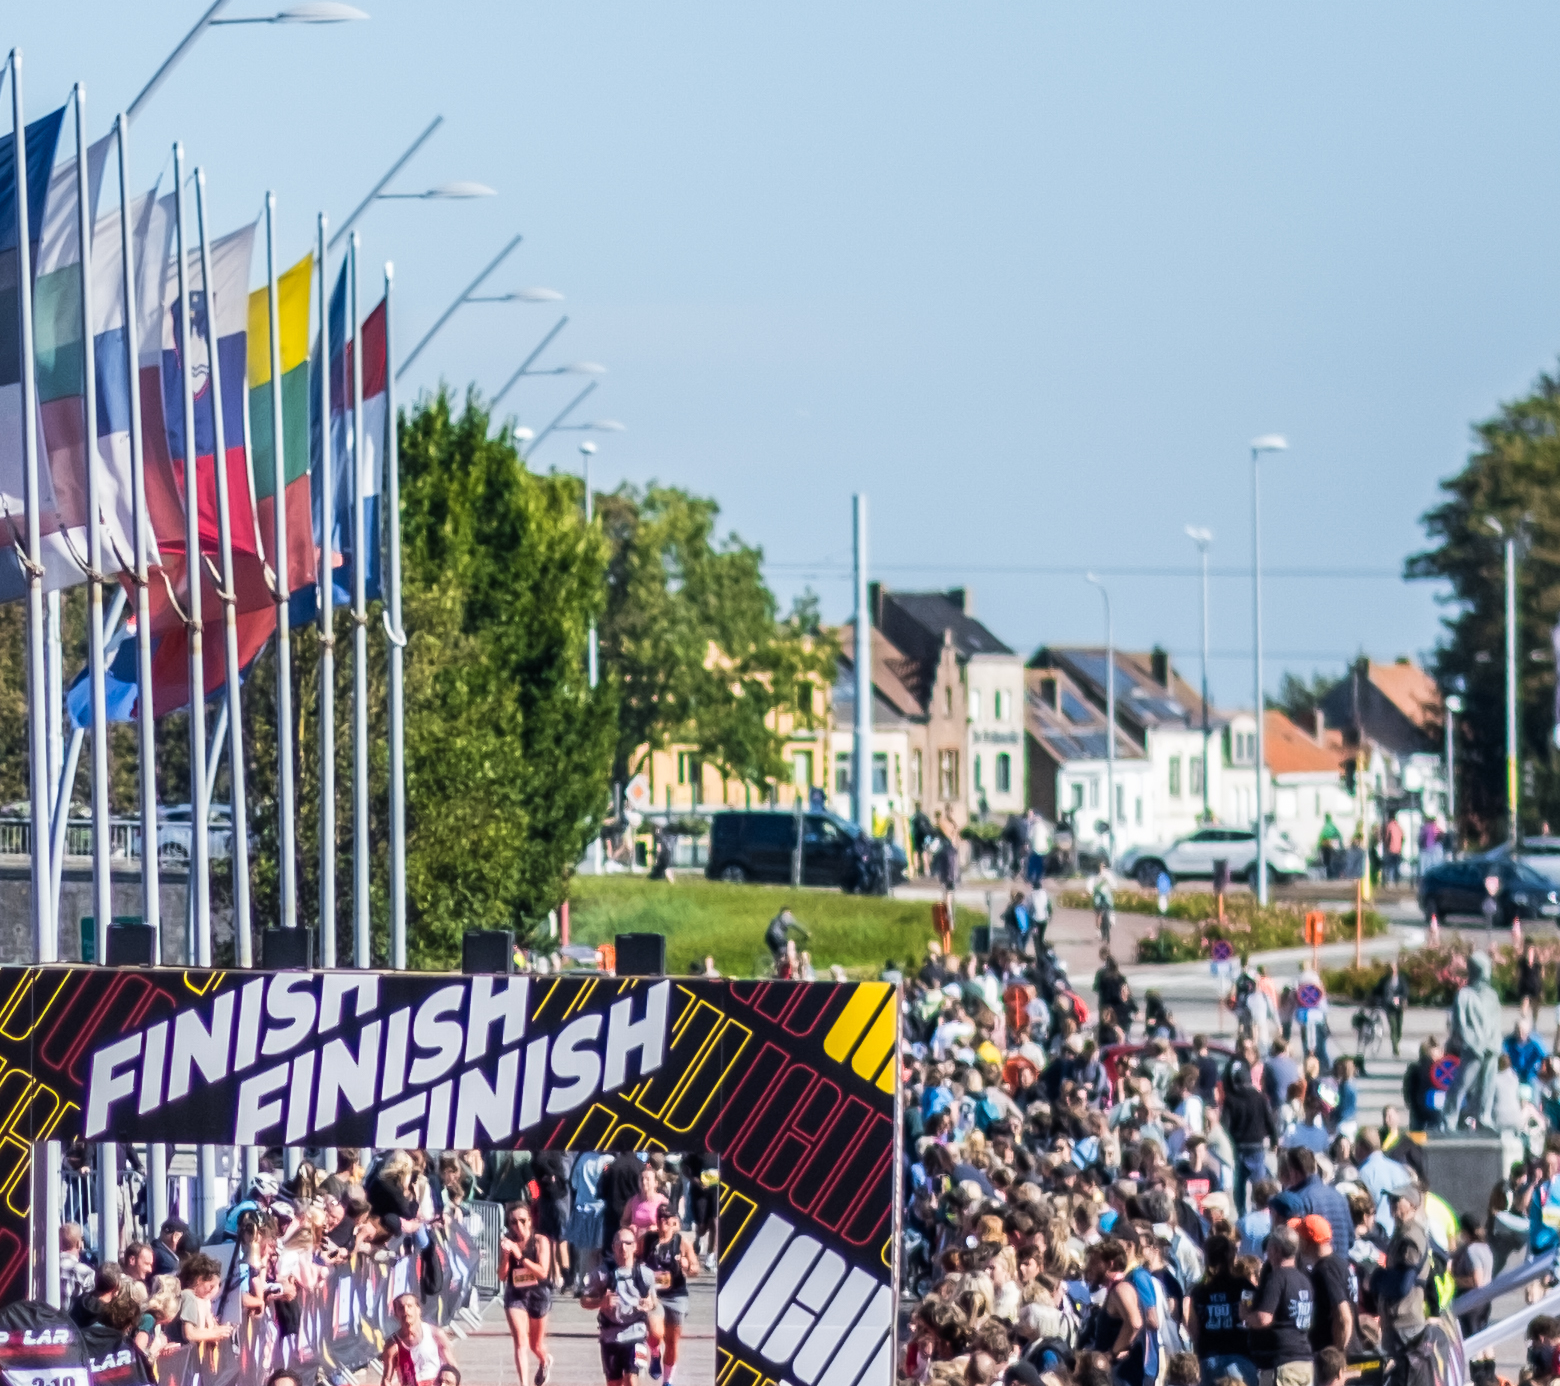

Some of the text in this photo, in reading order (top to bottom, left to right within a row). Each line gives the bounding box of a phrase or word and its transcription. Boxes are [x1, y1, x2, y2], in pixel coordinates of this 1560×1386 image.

[85, 973, 379, 1139] FINISH
[235, 975, 529, 1145] FINISH
[376, 979, 670, 1150] FINISH
